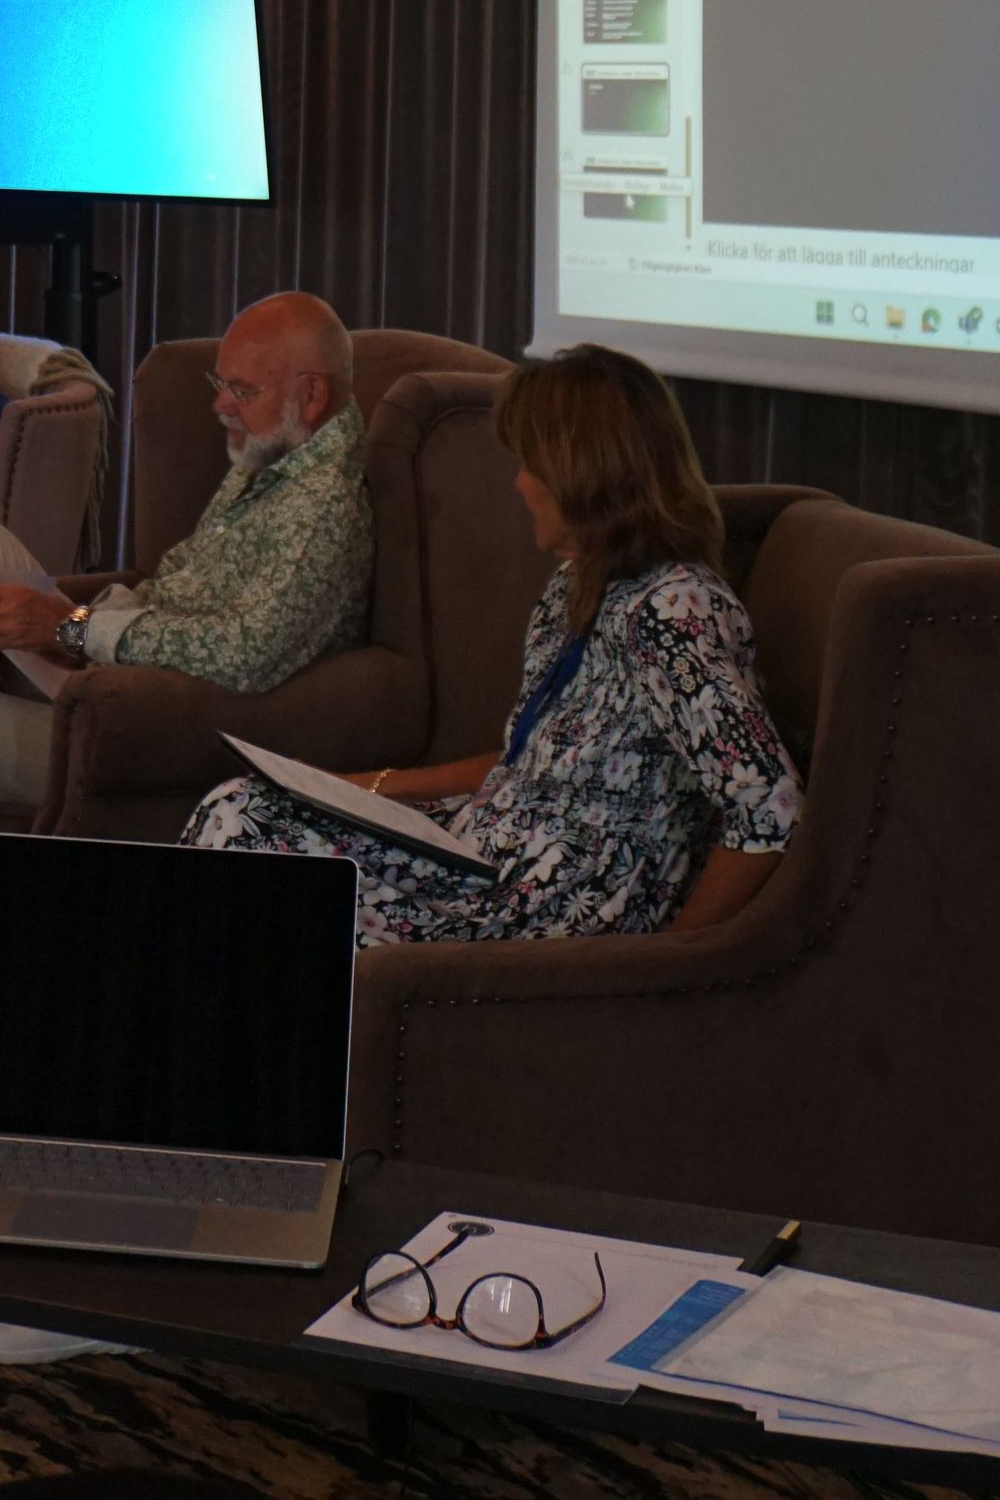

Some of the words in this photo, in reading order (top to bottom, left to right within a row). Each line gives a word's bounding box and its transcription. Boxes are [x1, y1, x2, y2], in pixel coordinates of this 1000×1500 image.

[707, 240, 748, 260] Klicka
[753, 242, 773, 261] för
[777, 245, 797, 262] att
[848, 248, 866, 267] till
